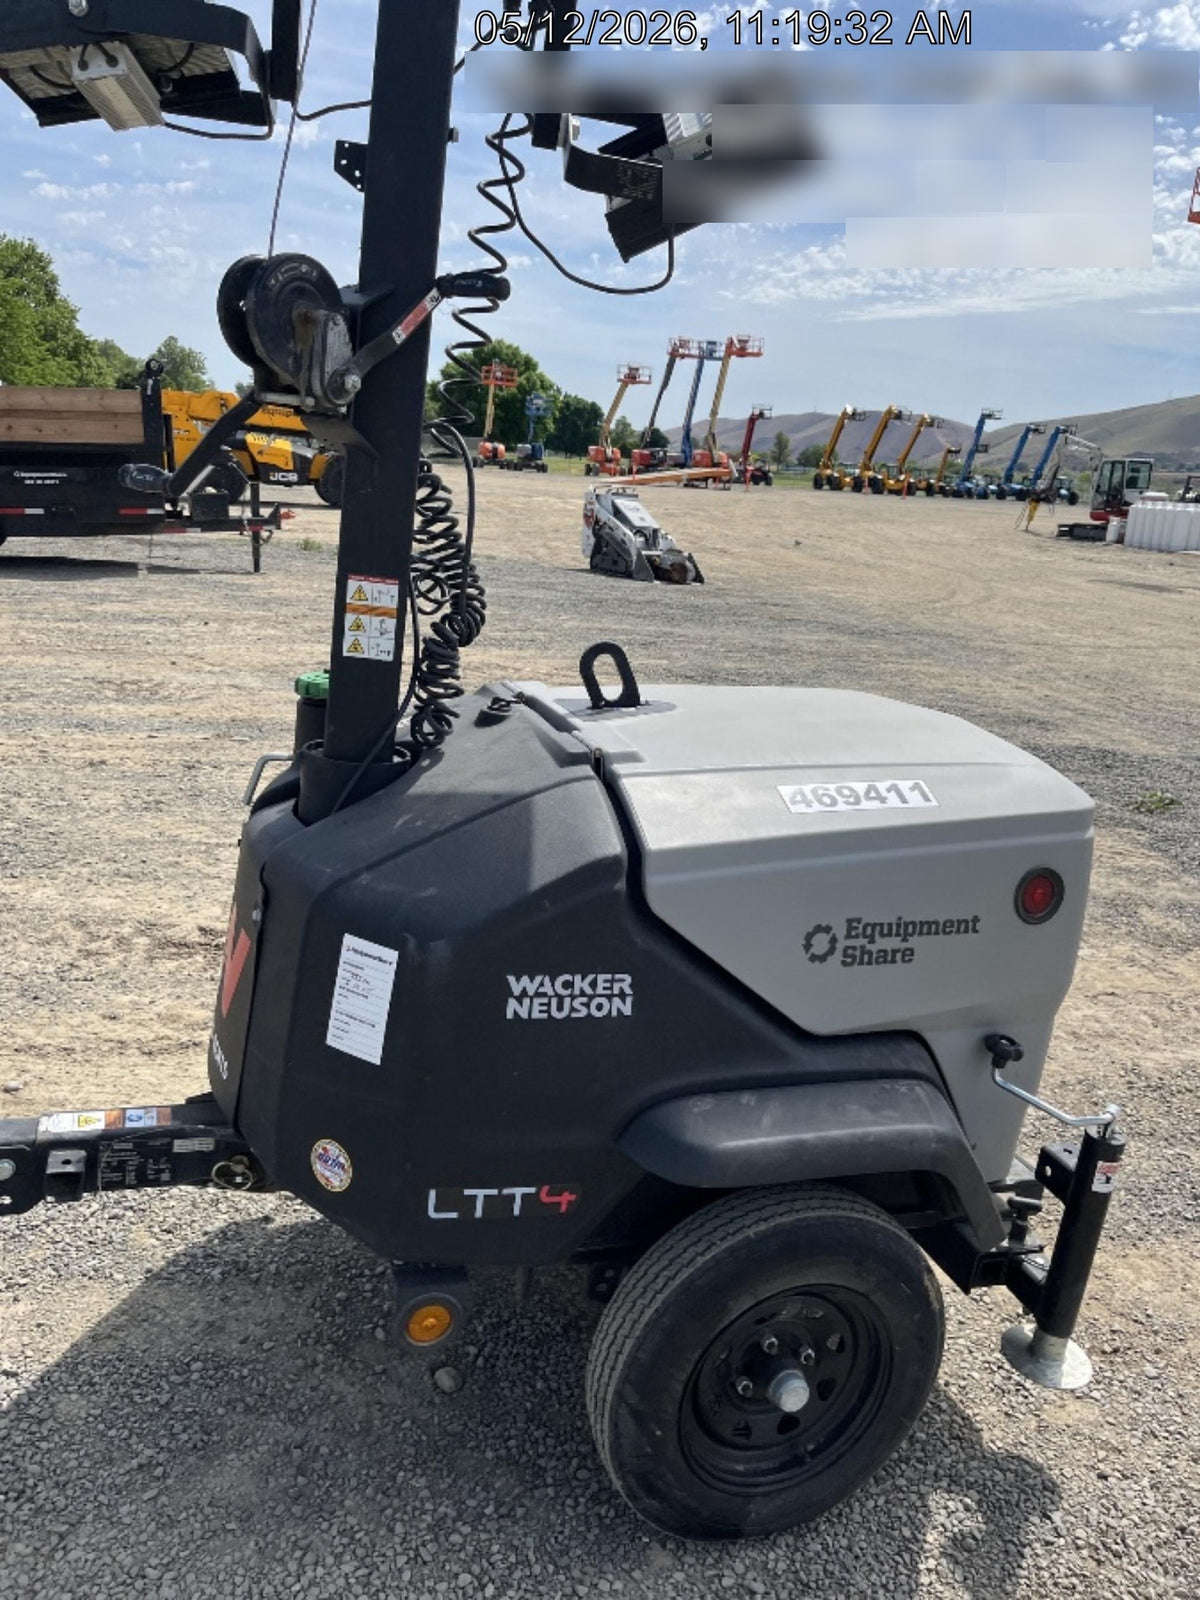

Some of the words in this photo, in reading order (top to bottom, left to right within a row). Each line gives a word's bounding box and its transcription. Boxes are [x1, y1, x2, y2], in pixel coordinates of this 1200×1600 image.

[269, 472, 298, 482] JCB
[789, 781, 934, 809] 469411
[844, 915, 980, 944] Equipment
[841, 944, 915, 967] Share
[506, 973, 633, 996] WACKER
[506, 996, 633, 1019] NEUSON
